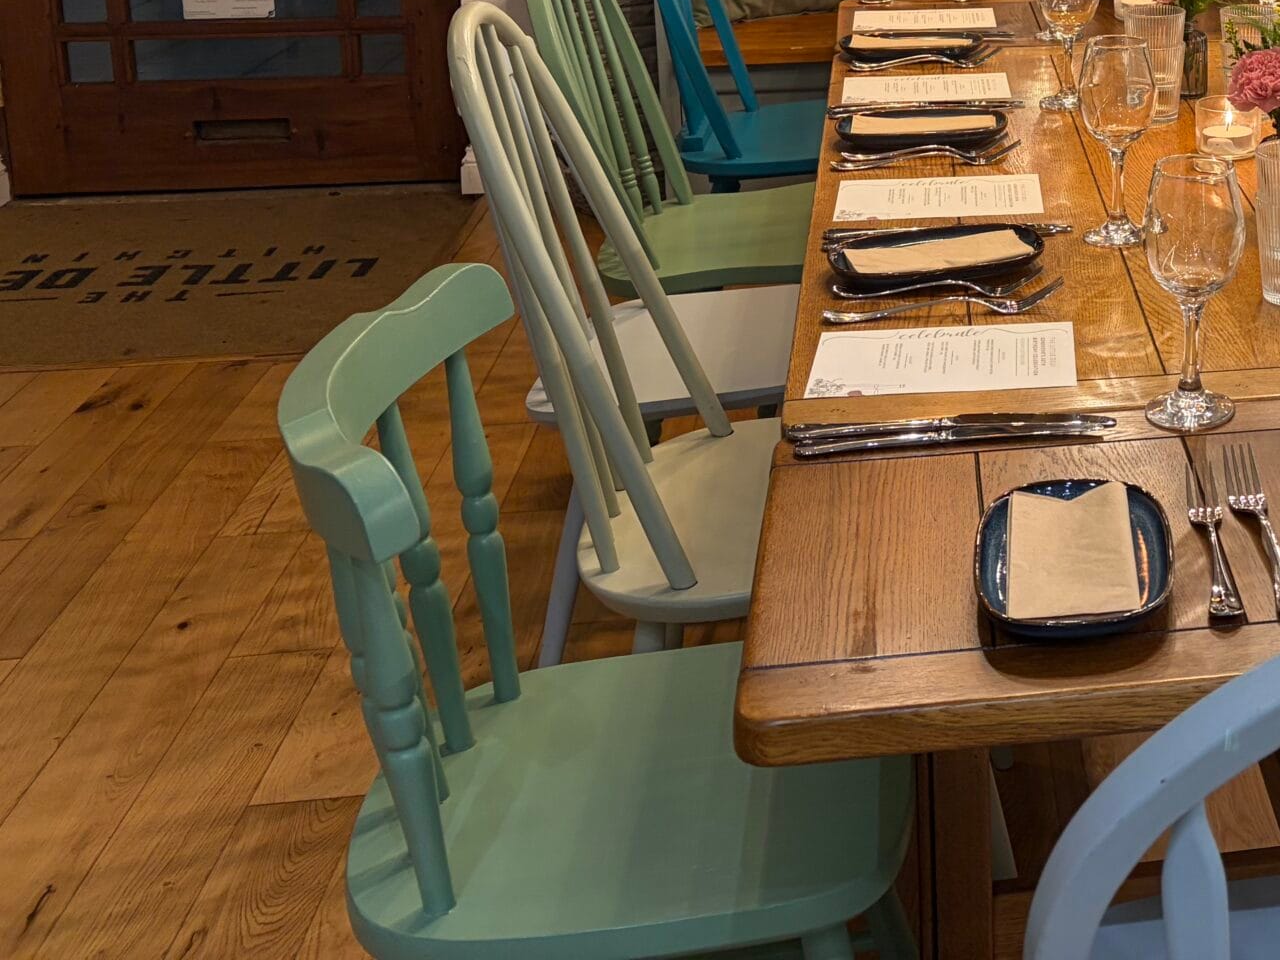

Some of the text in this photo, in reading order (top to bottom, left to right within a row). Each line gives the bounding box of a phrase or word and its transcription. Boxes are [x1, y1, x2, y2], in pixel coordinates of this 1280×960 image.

[117, 257, 380, 287] LITTLE
[77, 289, 190, 303] THE
[898, 327, 980, 340] celebrate
